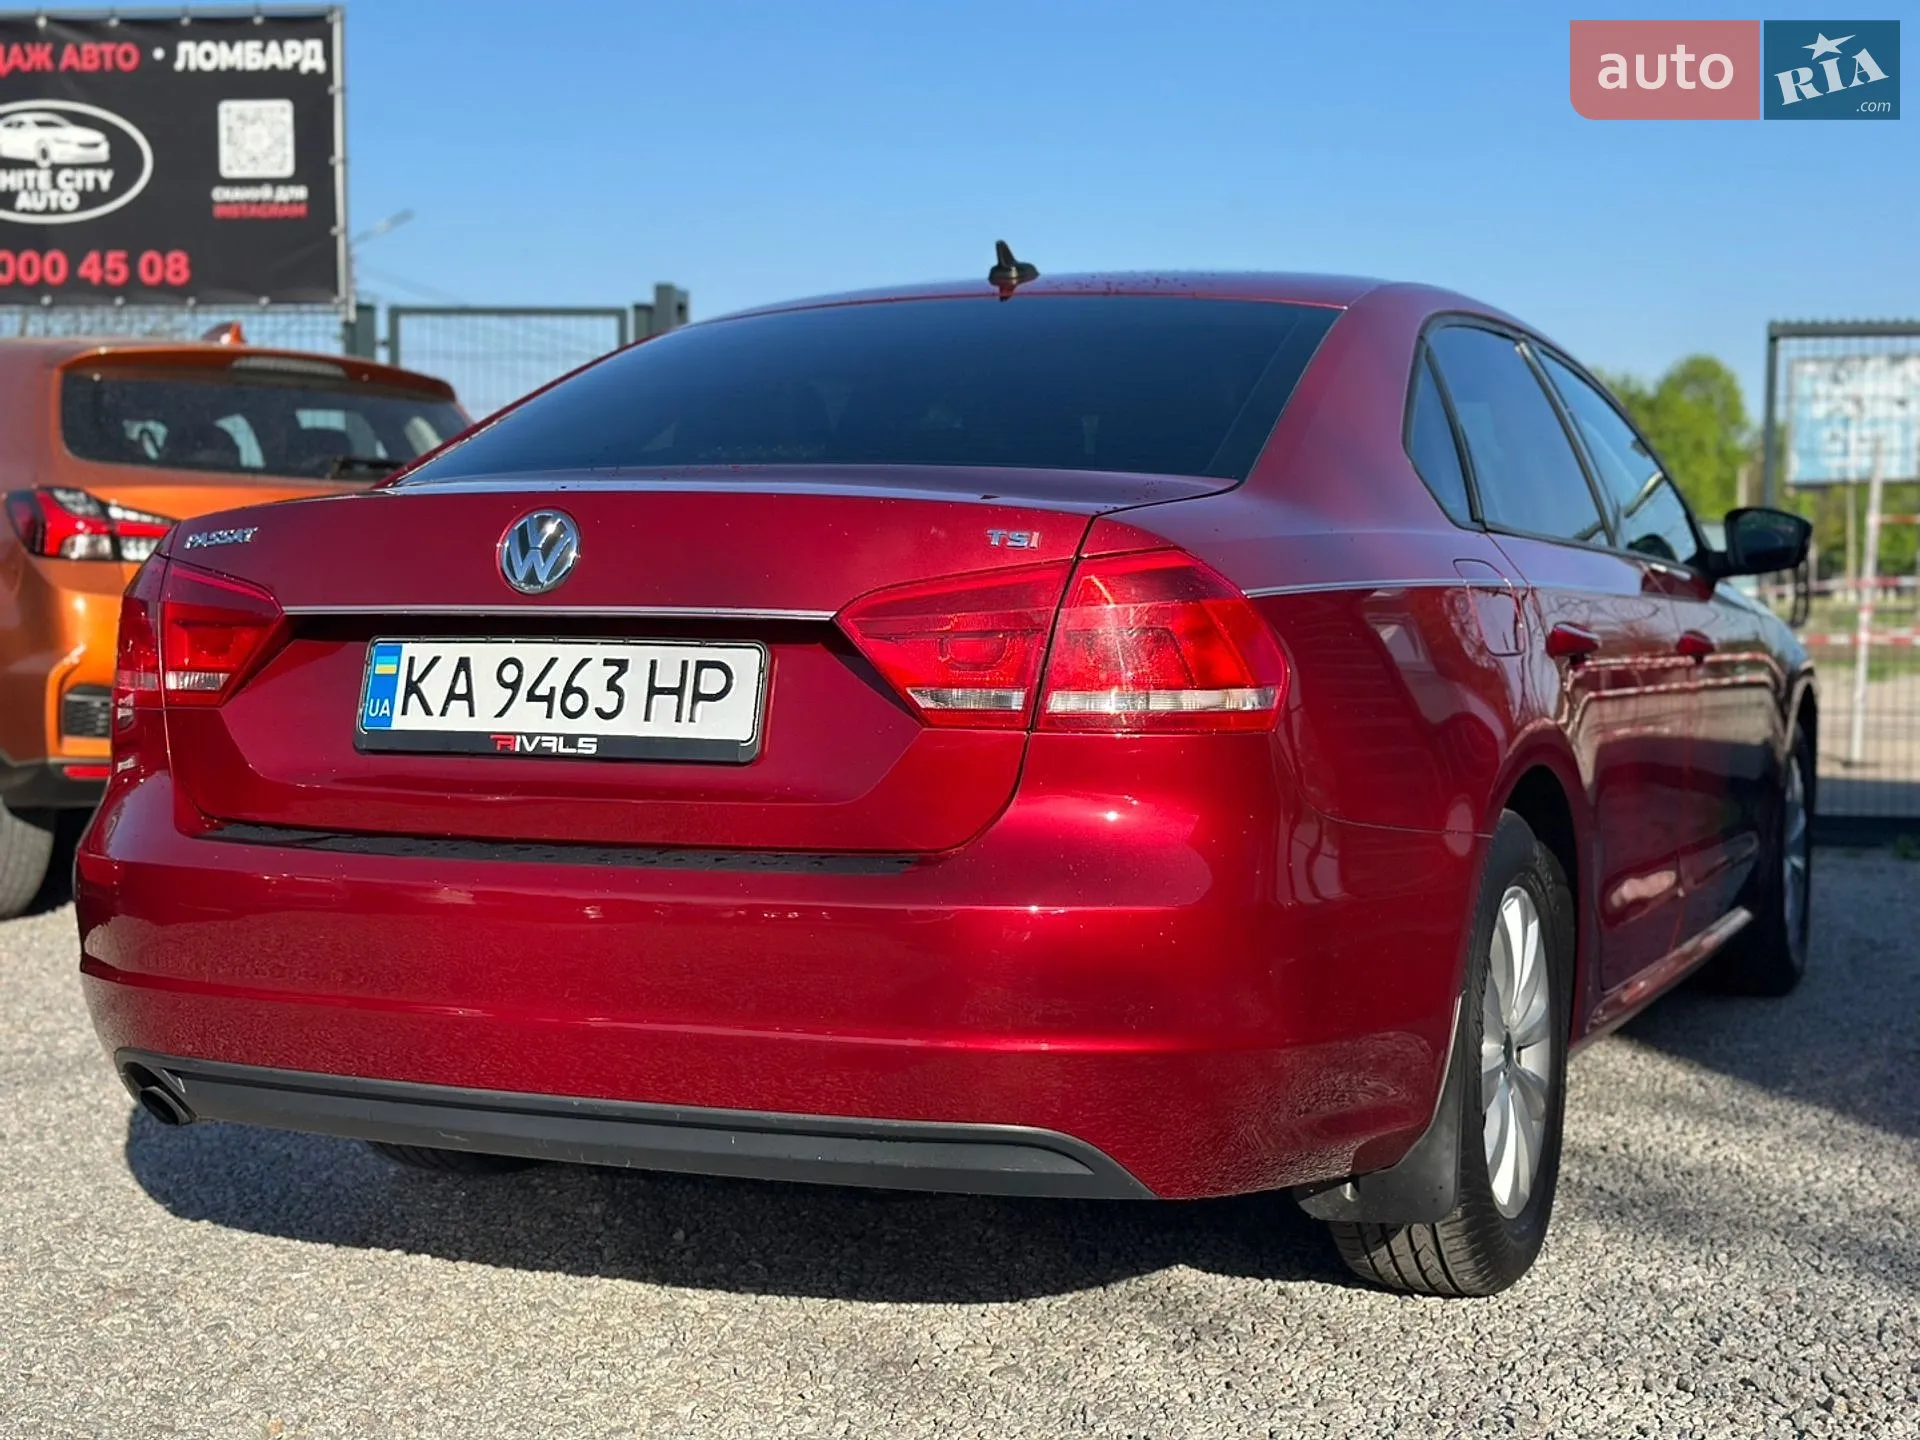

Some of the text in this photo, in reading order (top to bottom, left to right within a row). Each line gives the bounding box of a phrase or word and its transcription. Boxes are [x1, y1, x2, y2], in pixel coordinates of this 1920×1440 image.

[60, 41, 140, 72] АВТО
[173, 39, 327, 74] ЛОМБАРД
[56, 168, 115, 192] CITY
[15, 190, 80, 212] AUTO
[77, 249, 130, 286] 45
[138, 249, 191, 286] 08
[184, 526, 259, 549] PASSAT
[986, 528, 1041, 550] TSI
[400, 655, 734, 723] KA 9463 HP
[368, 698, 391, 717] UA
